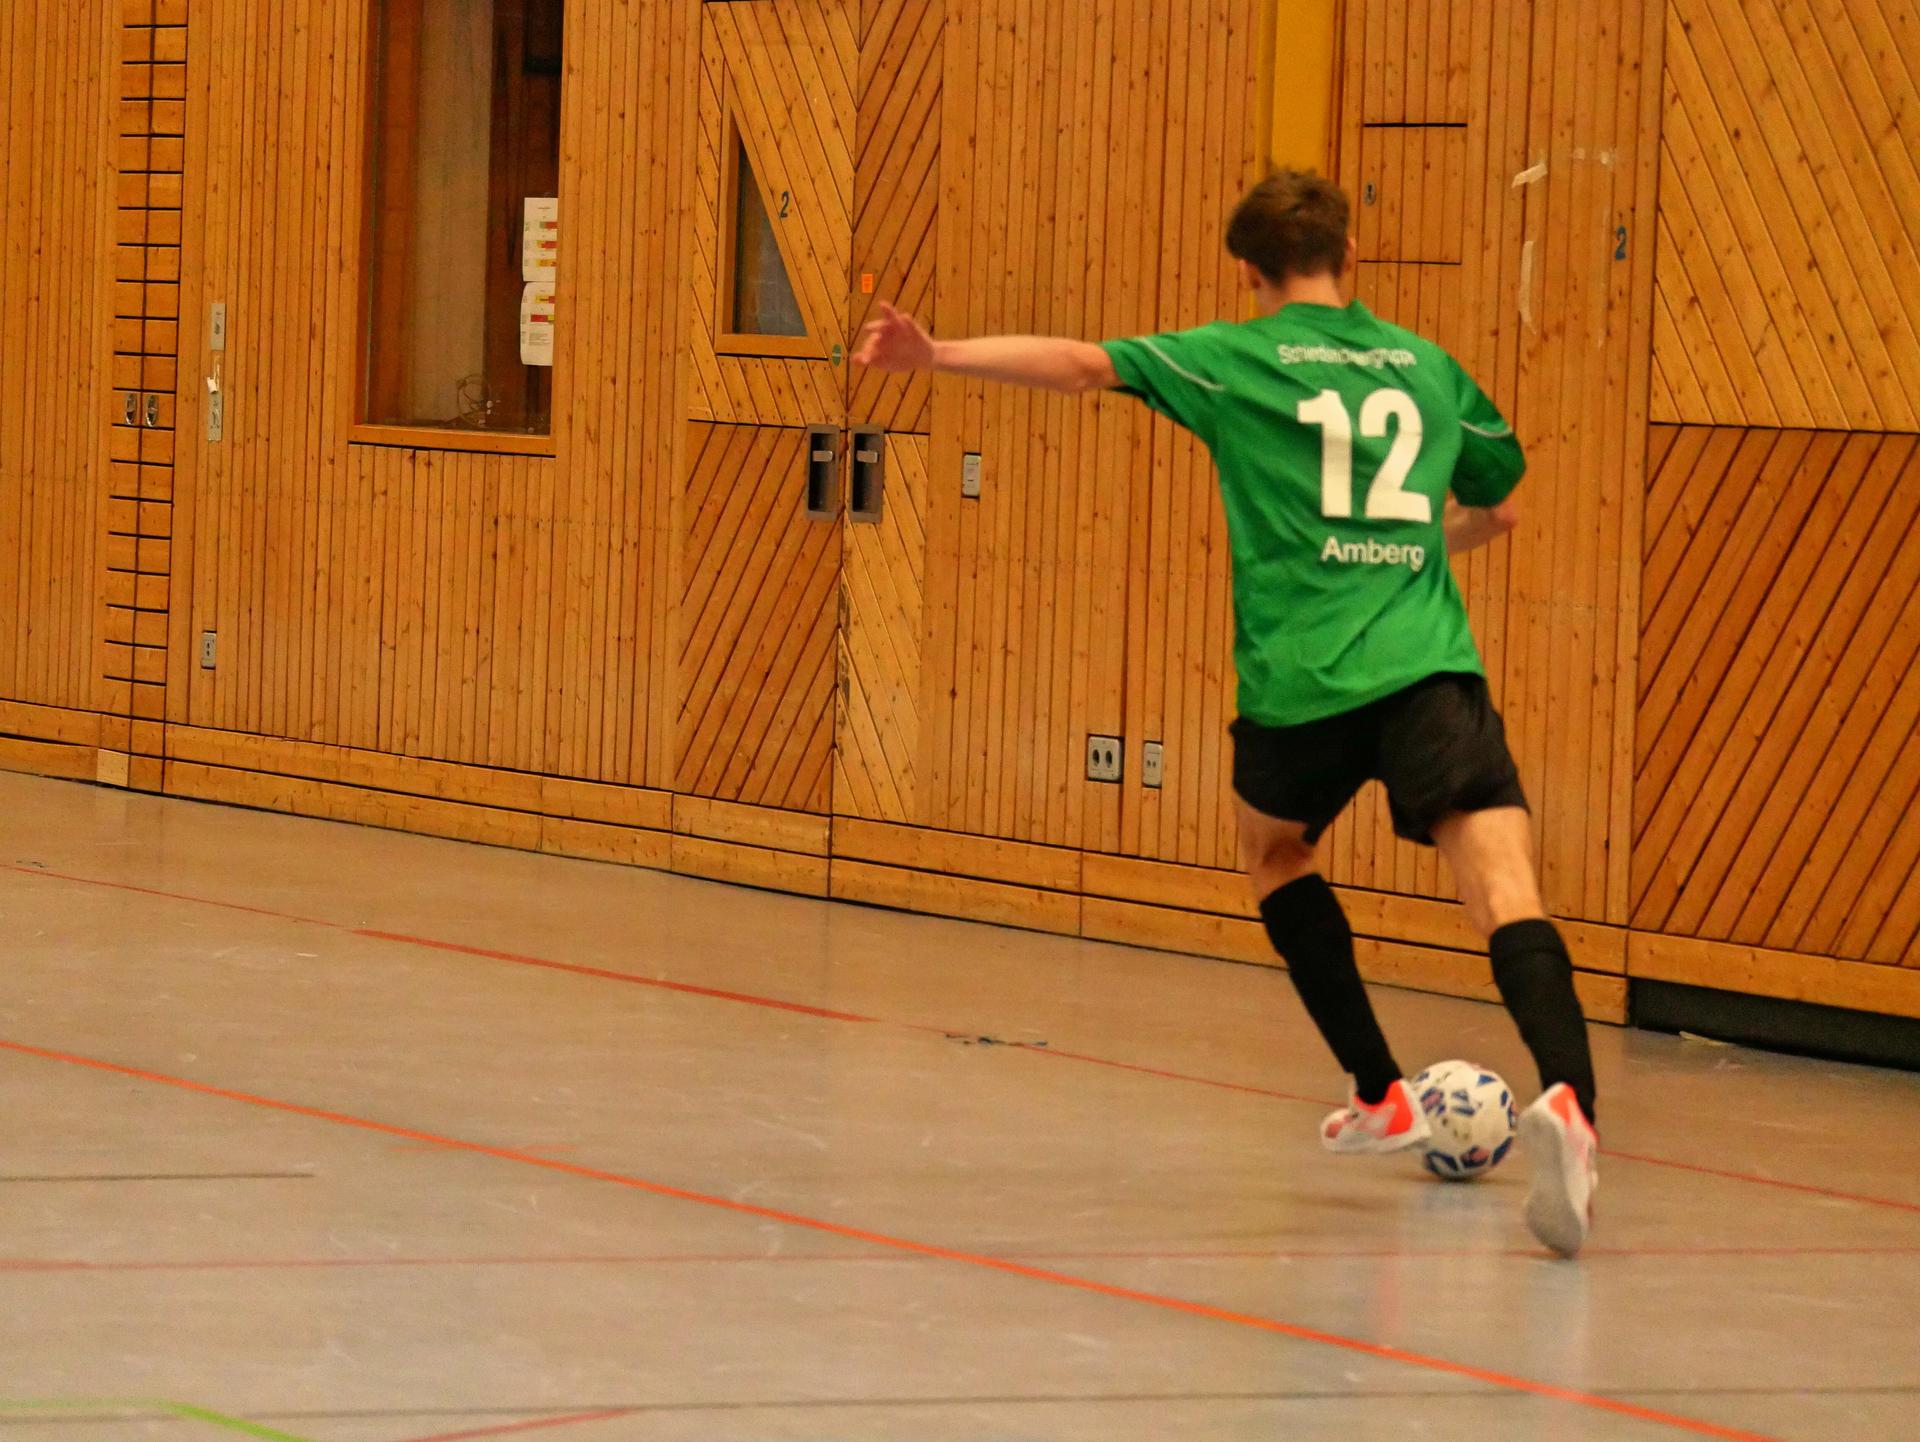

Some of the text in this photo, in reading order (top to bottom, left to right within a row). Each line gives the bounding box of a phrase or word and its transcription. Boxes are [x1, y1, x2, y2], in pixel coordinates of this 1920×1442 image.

[780, 191, 790, 218] 2
[1615, 225, 1627, 261] 2
[1296, 387, 1432, 523] 12
[1321, 535, 1425, 573] Amberg
